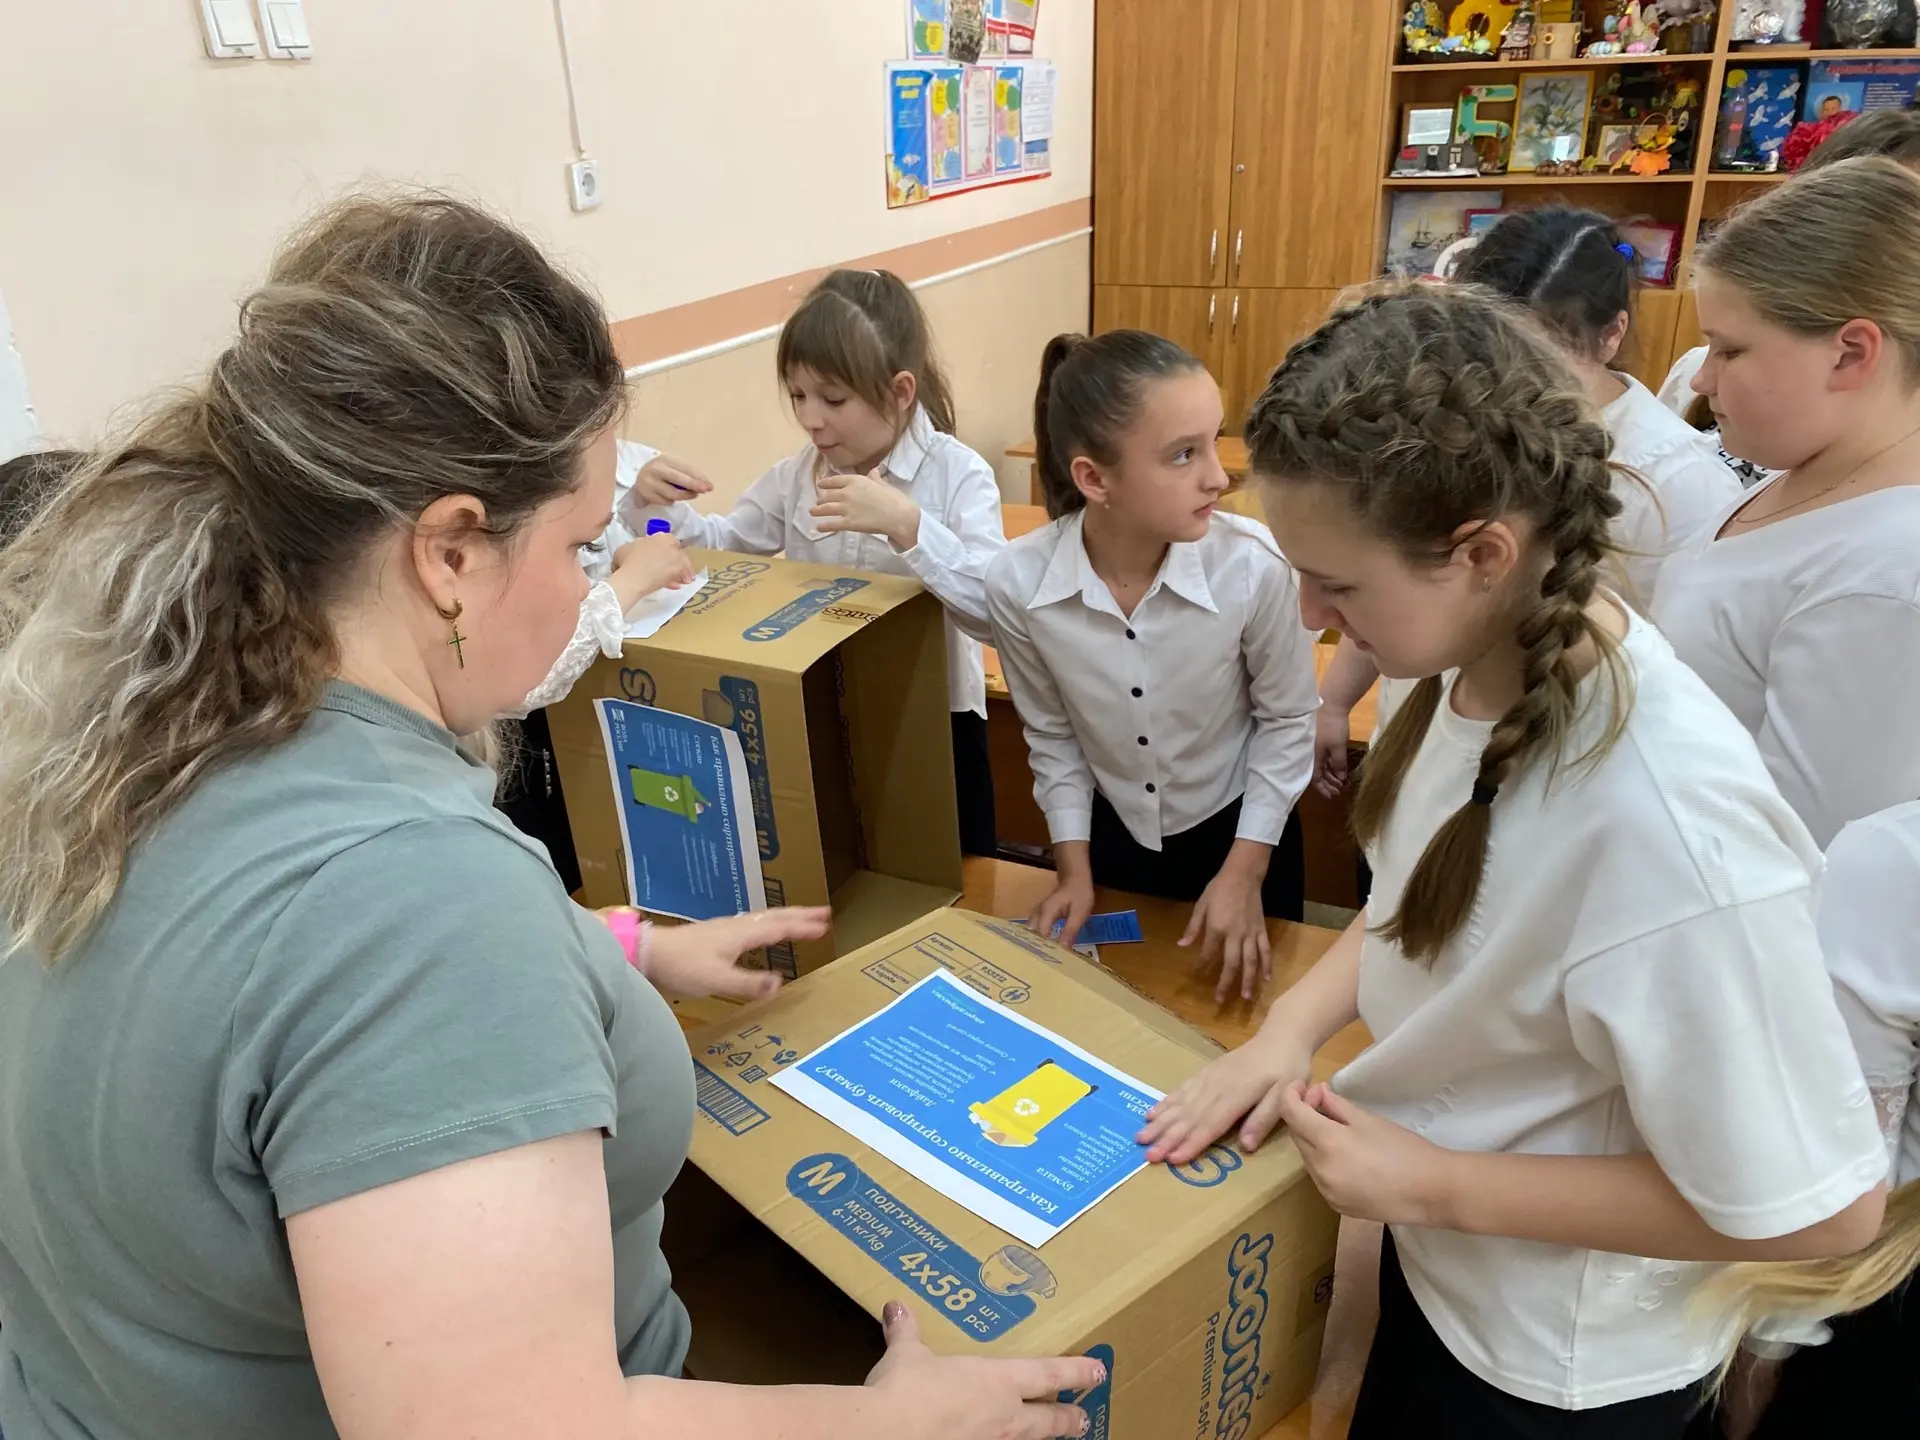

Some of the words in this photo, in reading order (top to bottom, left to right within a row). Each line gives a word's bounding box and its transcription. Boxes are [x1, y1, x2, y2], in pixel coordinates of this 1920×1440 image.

[710, 735, 720, 755] Как
[713, 757, 728, 816] правильно
[722, 818, 739, 882] сортировать
[734, 884, 743, 912] стекл
[815, 1065, 866, 1097] бумагу?
[1119, 1090, 1155, 1112] ОССИИ
[1126, 1102, 1150, 1117] ОДА
[867, 1094, 948, 1147] сортировать
[798, 1161, 846, 1195] M
[948, 1146, 1028, 1195] правильно
[1036, 1167, 1074, 1191] Бумага
[832, 1208, 857, 1226] 6-11
[844, 1200, 893, 1238] MEDIUM
[1026, 1192, 1059, 1214] Как
[865, 1188, 949, 1252] ПОДГУЗНИКИ
[899, 1252, 977, 1311] 4x58
[963, 1314, 990, 1334] pcs
[979, 1305, 1001, 1324] шт.
[1201, 1311, 1220, 1400] Premium
